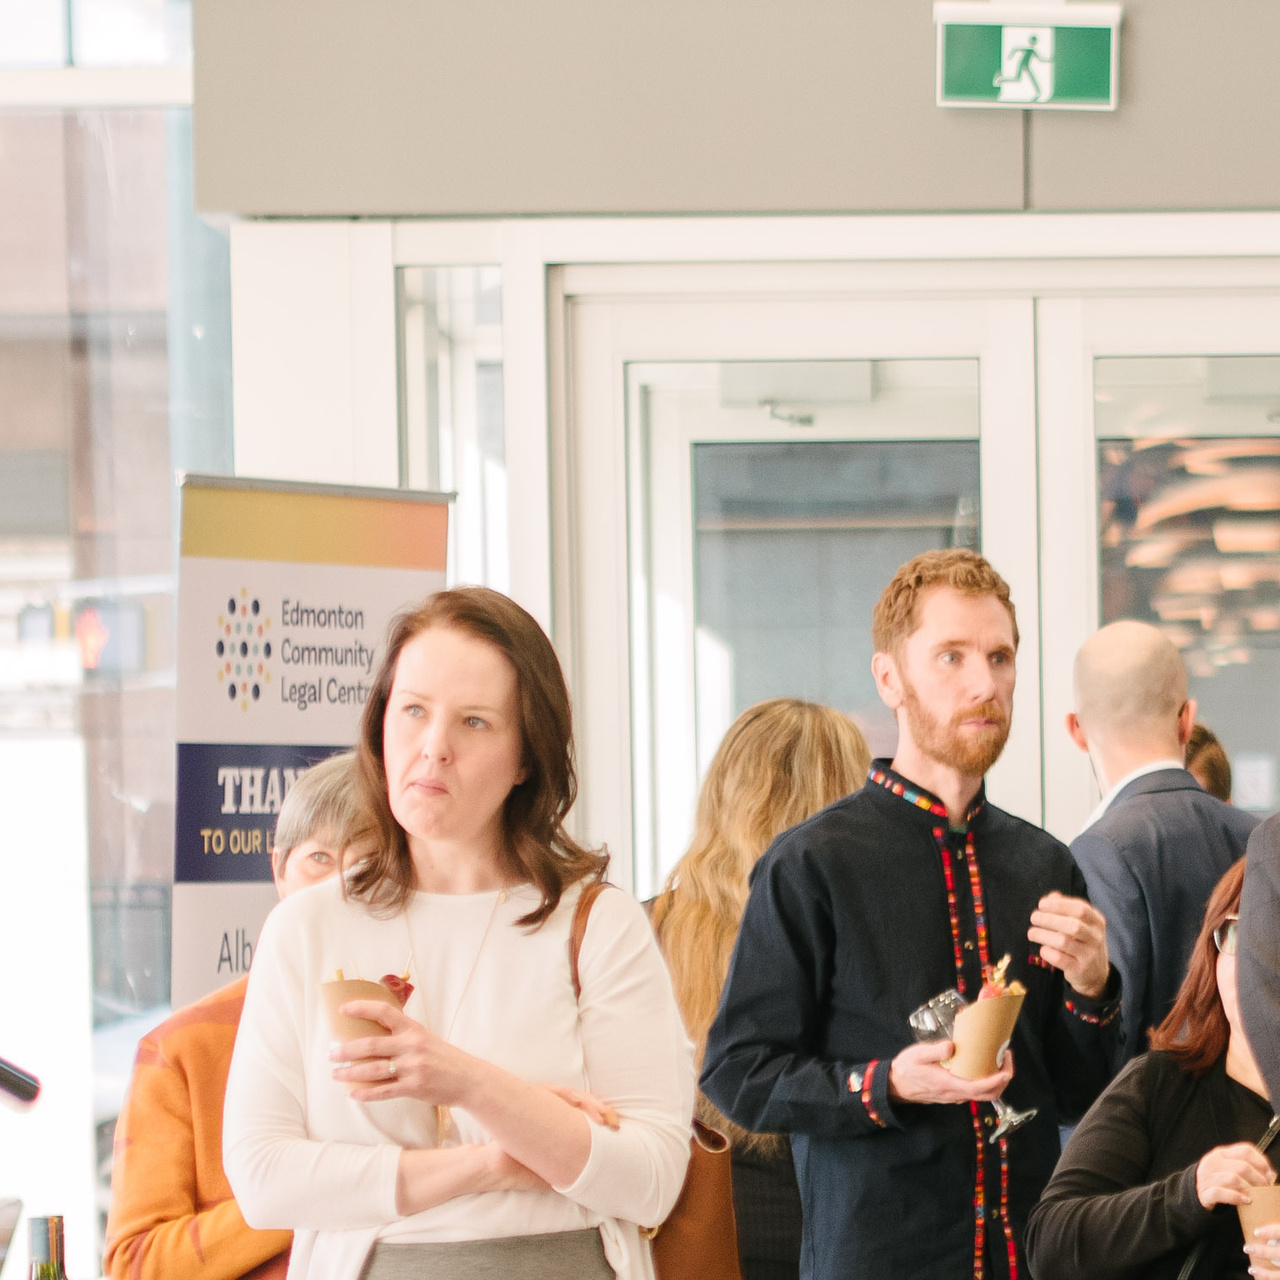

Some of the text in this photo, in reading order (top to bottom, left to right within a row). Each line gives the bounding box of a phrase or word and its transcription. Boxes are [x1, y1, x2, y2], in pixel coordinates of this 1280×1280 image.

[281, 599, 364, 630] Edmonton
[280, 638, 375, 675] Community
[281, 676, 322, 711] Legal
[201, 828, 225, 855] TO
[229, 828, 262, 855] OUR
